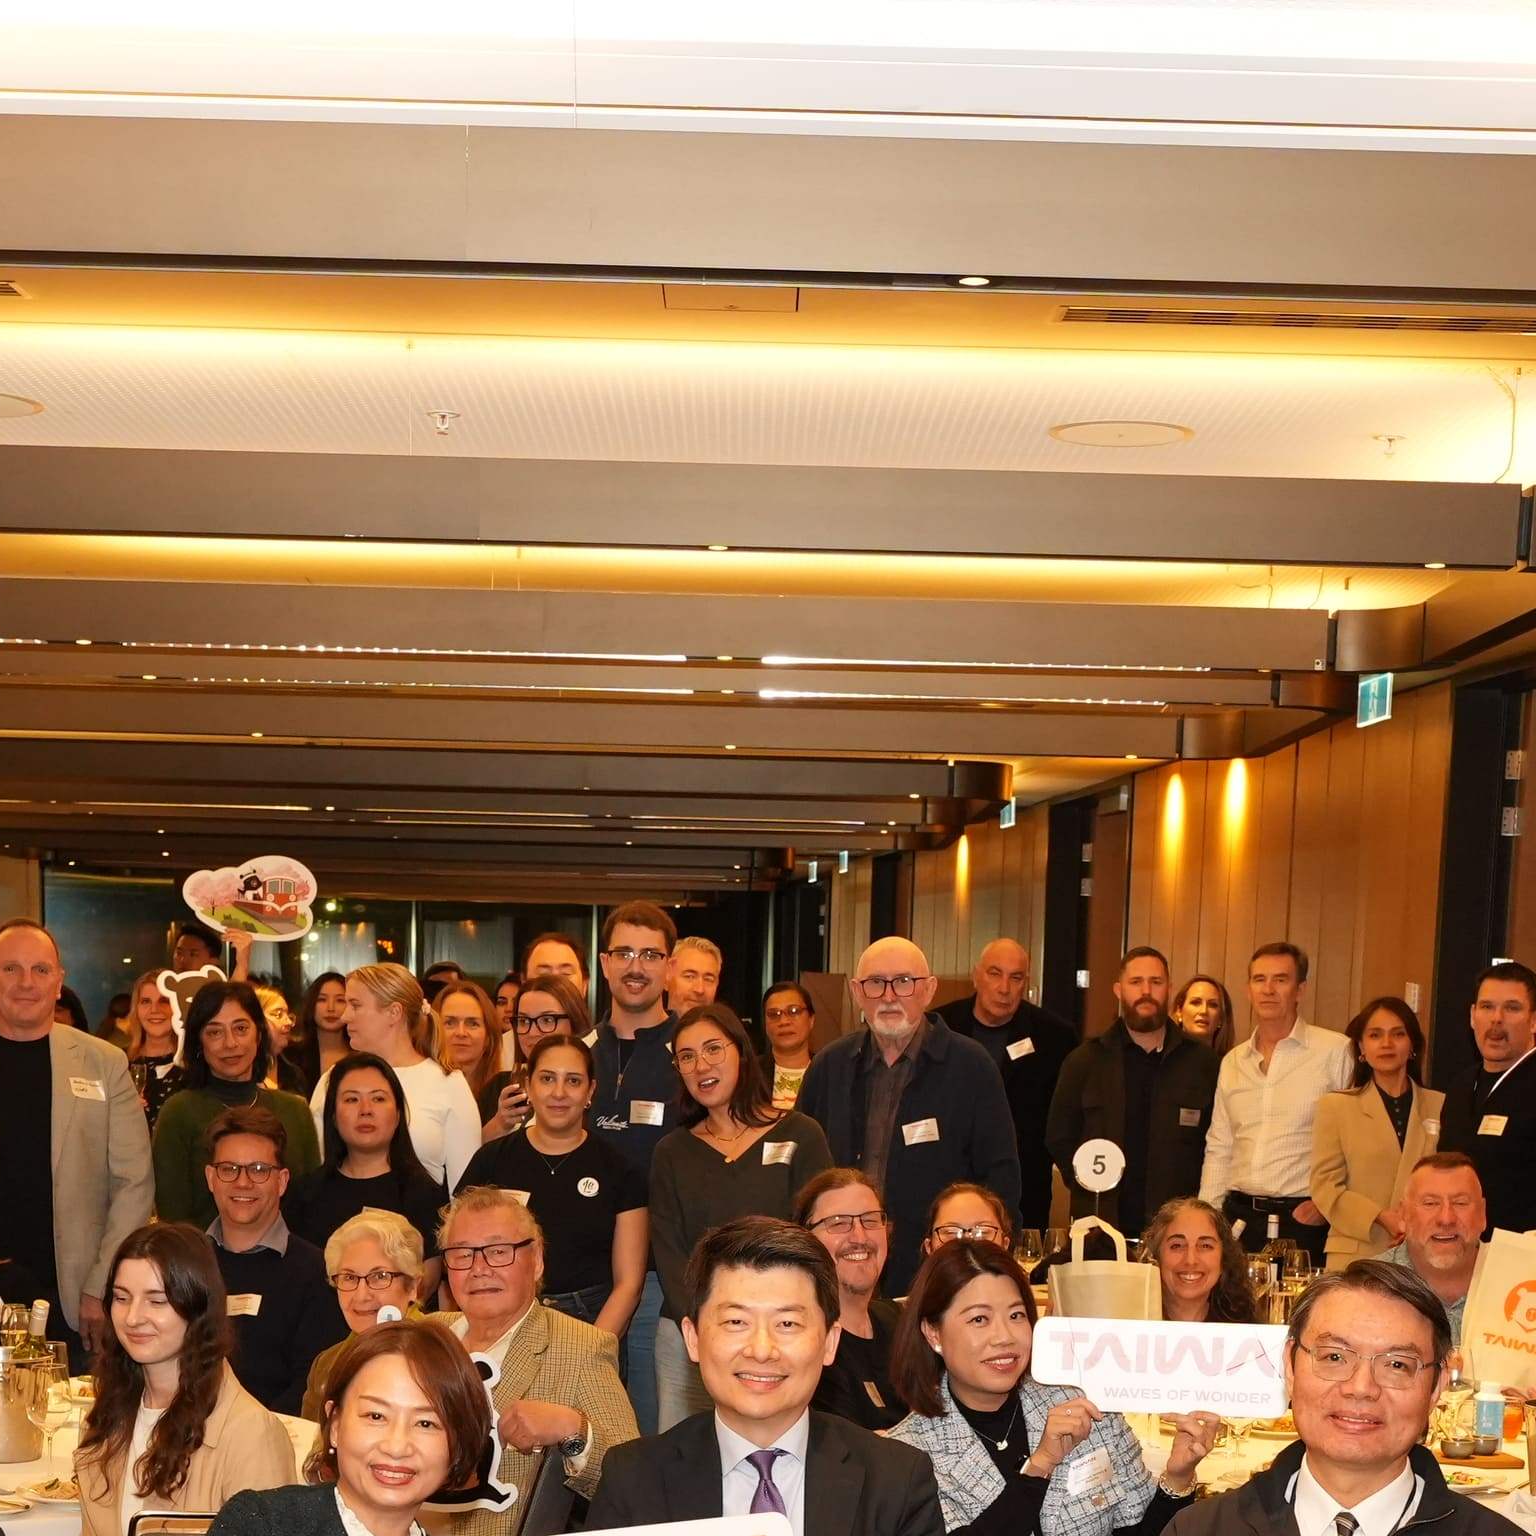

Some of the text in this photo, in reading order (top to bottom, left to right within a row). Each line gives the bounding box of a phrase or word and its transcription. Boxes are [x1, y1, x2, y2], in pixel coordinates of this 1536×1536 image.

[1092, 1154, 1106, 1175] 5
[1049, 1330, 1277, 1378] TAIWA
[1103, 1386, 1271, 1404] WAVES OF WONDER
